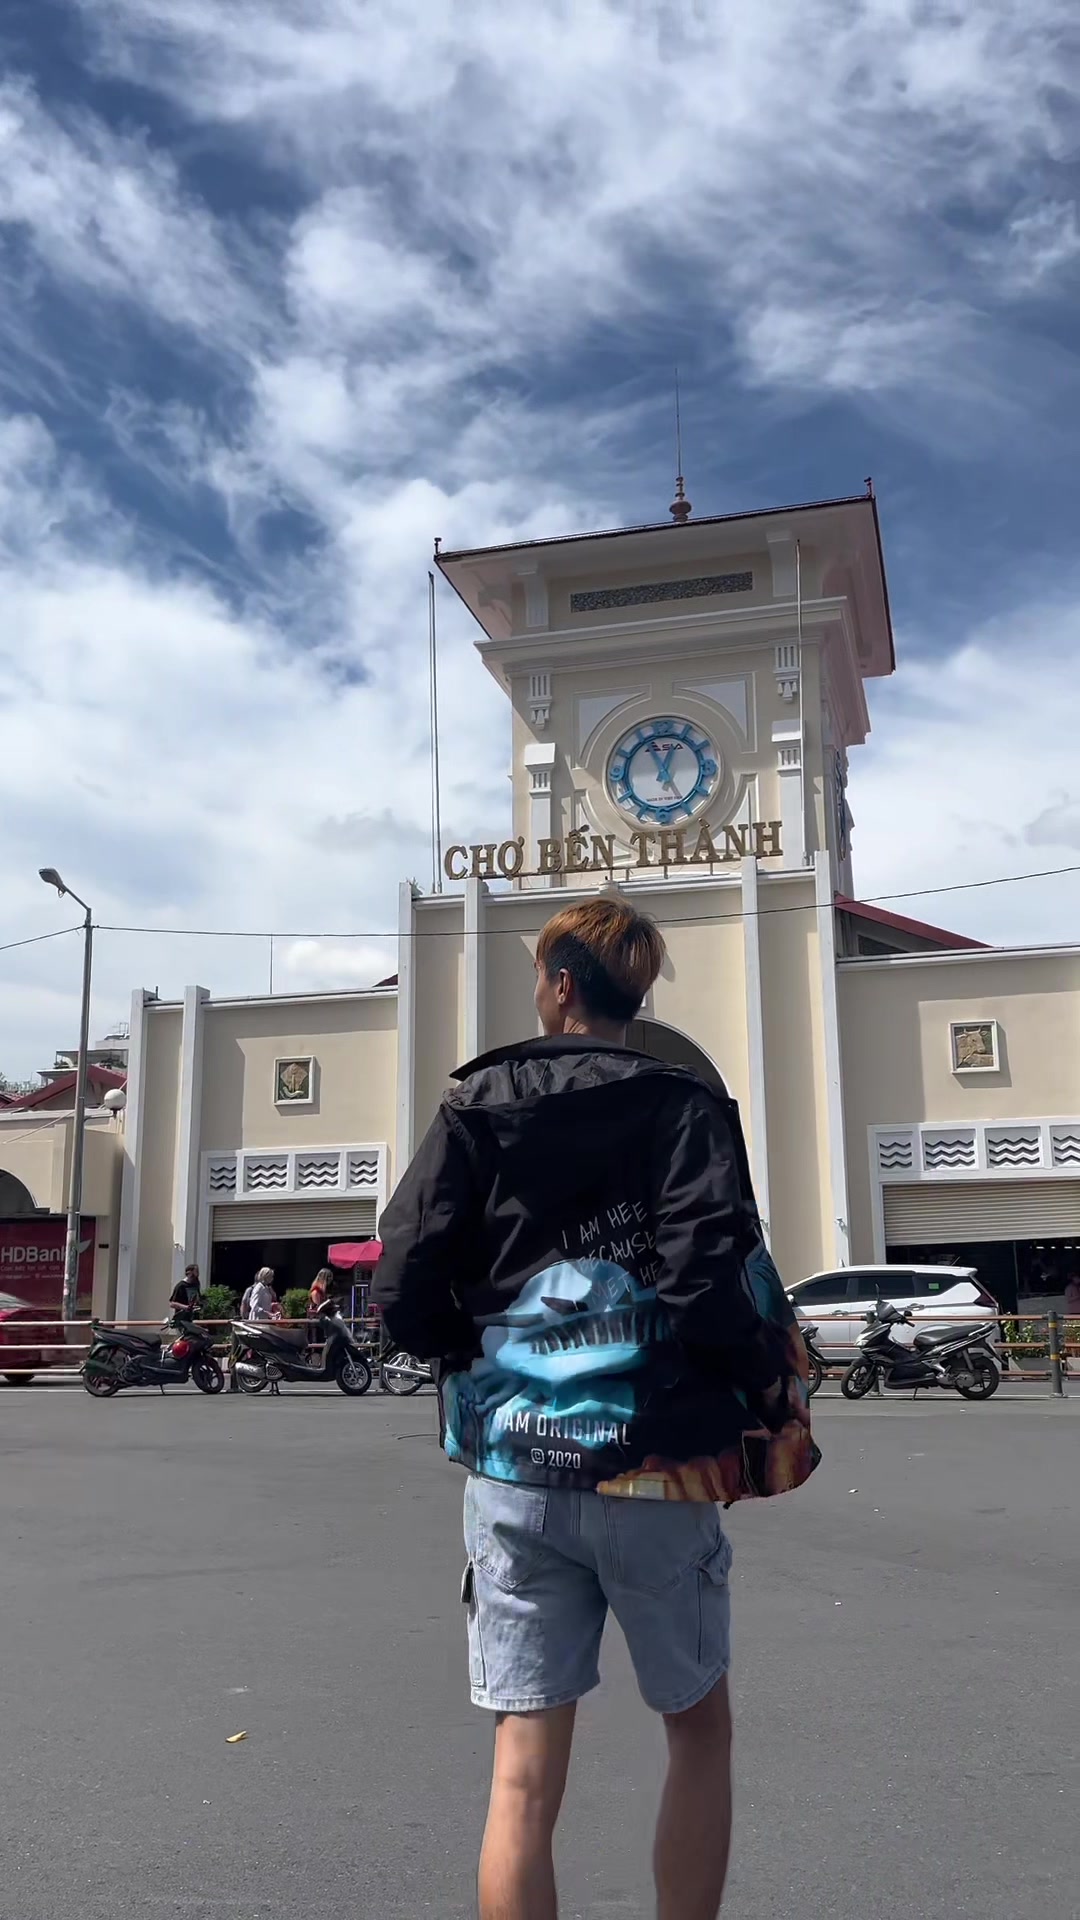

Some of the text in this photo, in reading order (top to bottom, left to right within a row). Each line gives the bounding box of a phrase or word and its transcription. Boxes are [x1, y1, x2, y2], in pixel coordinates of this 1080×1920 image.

[609, 764, 624, 781] 9
[655, 806, 672, 826] 6
[444, 817, 784, 880] CHỢ BẾN THÀNH
[561, 1230, 568, 1249] I
[579, 1216, 600, 1245] AM
[536, 1414, 631, 1445] ORIGINAL
[547, 1450, 581, 1469] 2020
